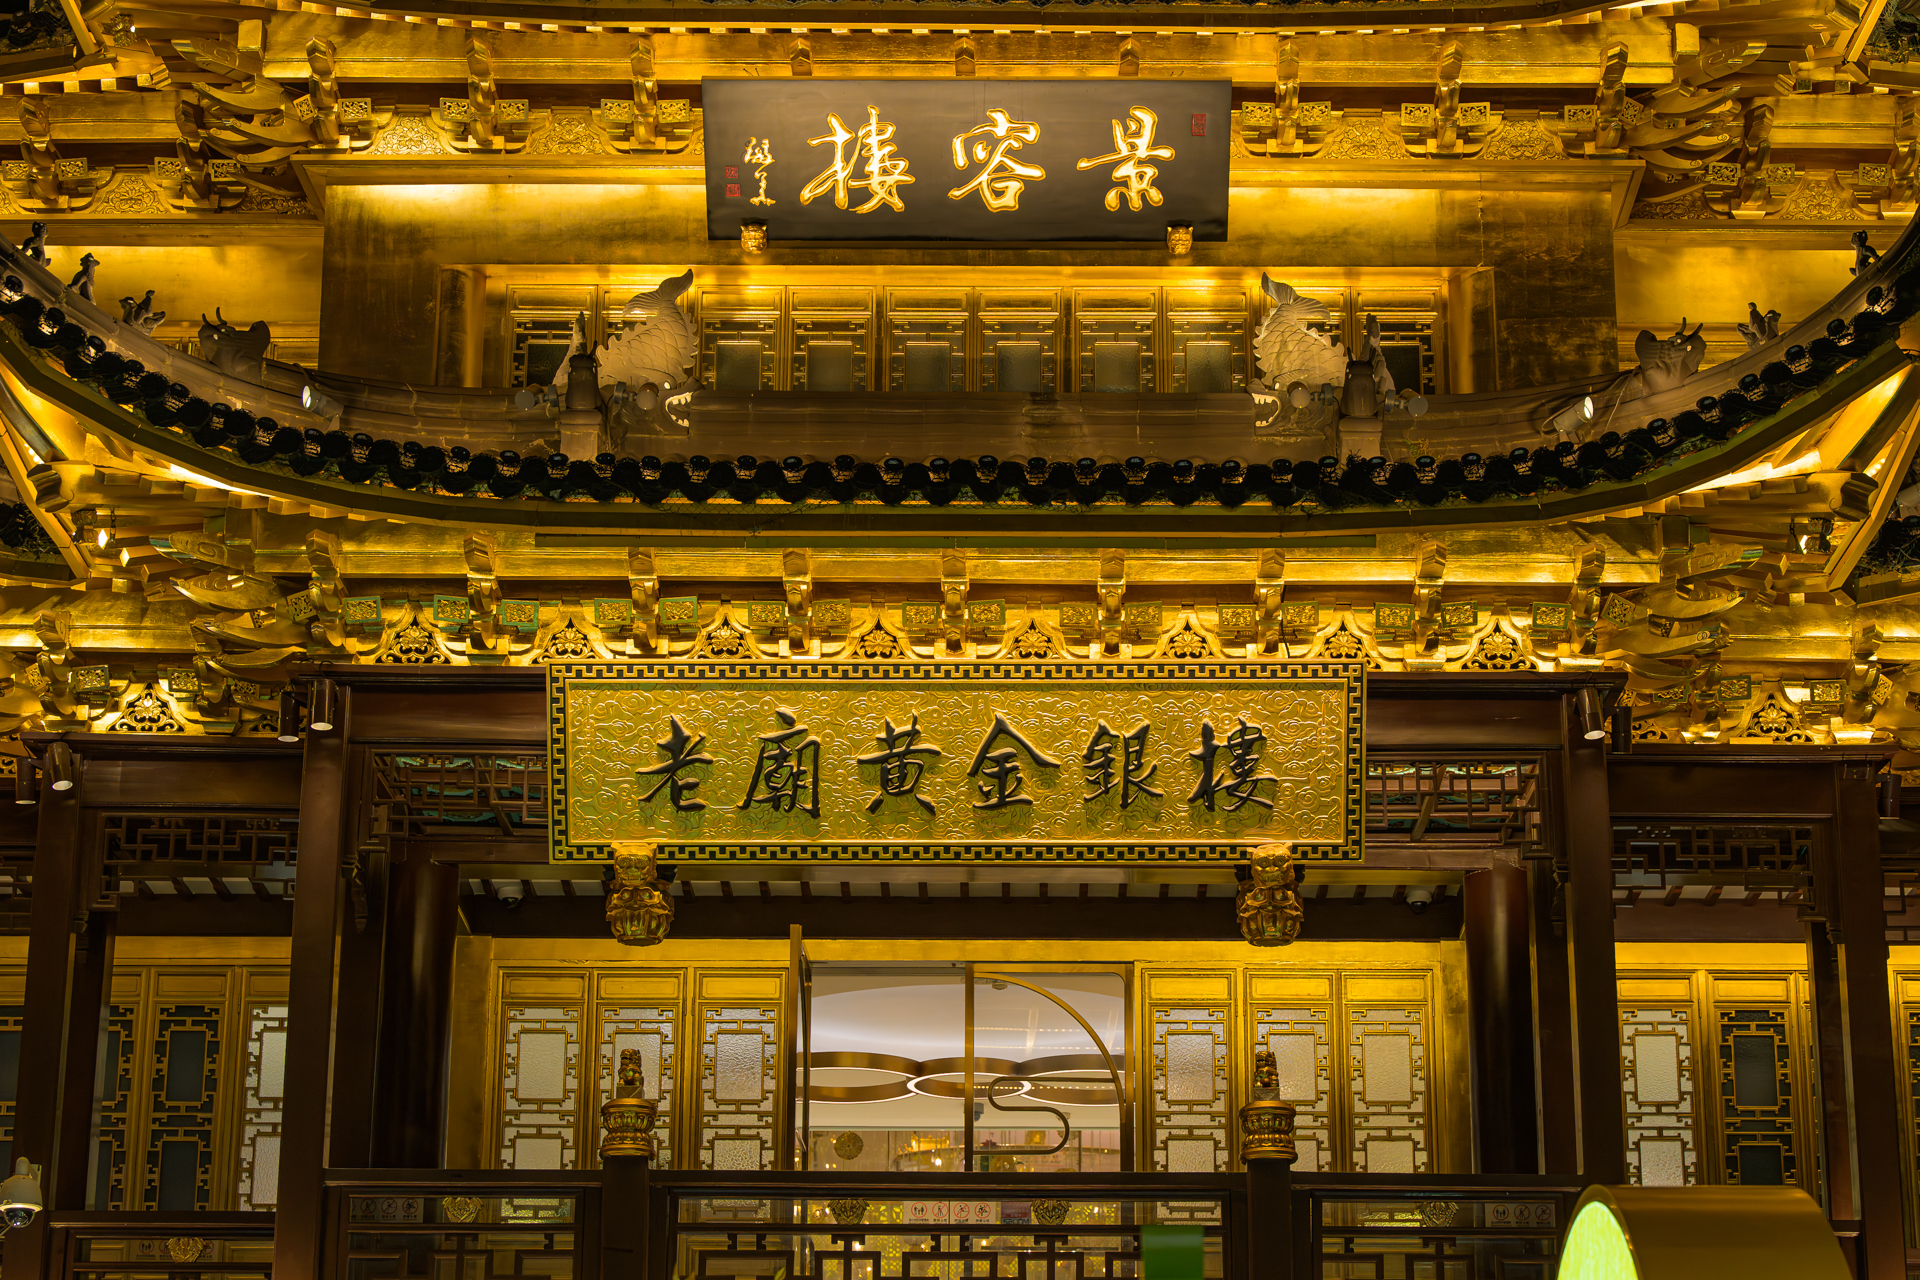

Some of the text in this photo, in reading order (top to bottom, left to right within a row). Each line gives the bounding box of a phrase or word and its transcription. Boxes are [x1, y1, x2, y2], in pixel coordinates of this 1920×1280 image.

[635, 707, 1279, 820] 老廟黃金銀樓
